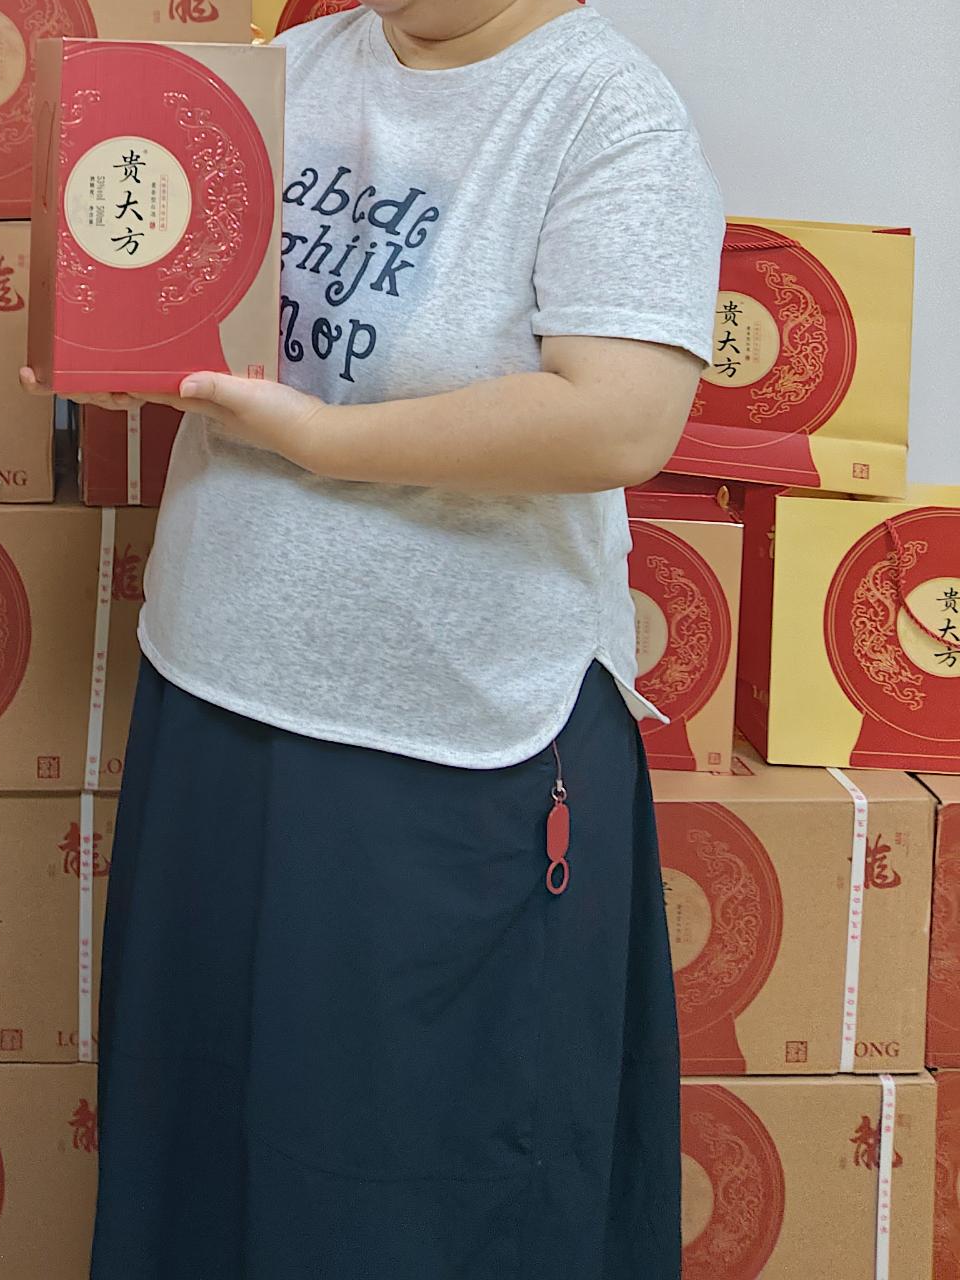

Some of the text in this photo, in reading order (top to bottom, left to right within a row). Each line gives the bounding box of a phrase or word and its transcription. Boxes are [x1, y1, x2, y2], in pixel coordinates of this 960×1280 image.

[110, 149, 147, 256] 贵大方
[714, 300, 743, 378] 贵大方
[854, 1041, 900, 1059] ONG
